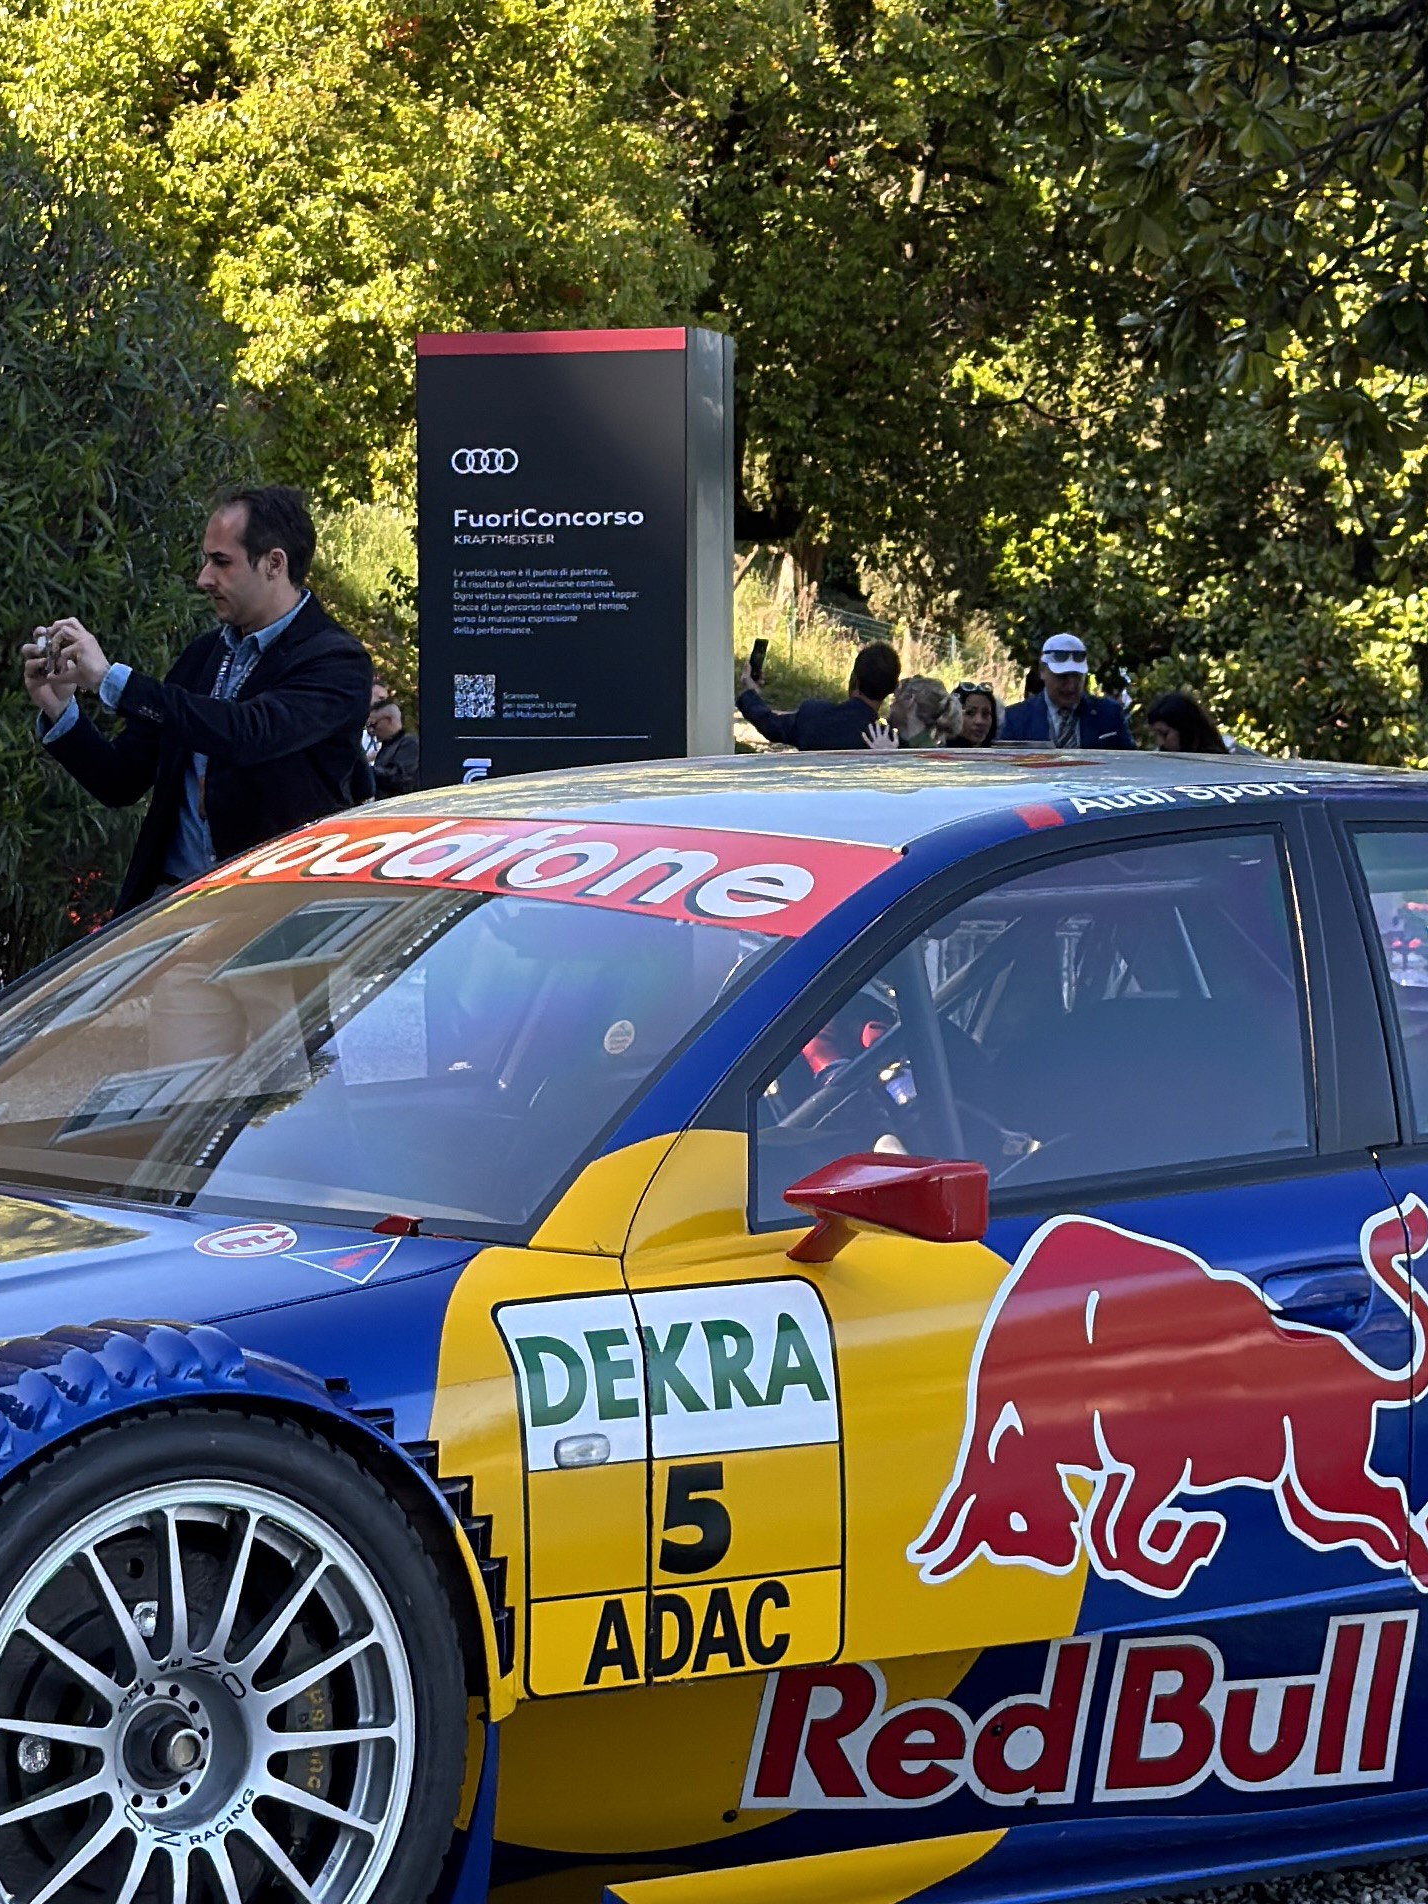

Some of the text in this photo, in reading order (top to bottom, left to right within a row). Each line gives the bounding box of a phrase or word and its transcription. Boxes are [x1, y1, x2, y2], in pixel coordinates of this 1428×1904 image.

[453, 508, 644, 528] FuoriConcorso
[453, 534, 555, 545] KRAFTMEISTER
[1070, 782, 1309, 814] Audi Sport
[204, 820, 816, 918] vodafone
[514, 1312, 830, 1428] DEKRA
[659, 1461, 732, 1574] 5
[583, 1580, 791, 1686] ADAC
[741, 1609, 1419, 1808] Red Bull
[189, 1788, 255, 1846] RACING
